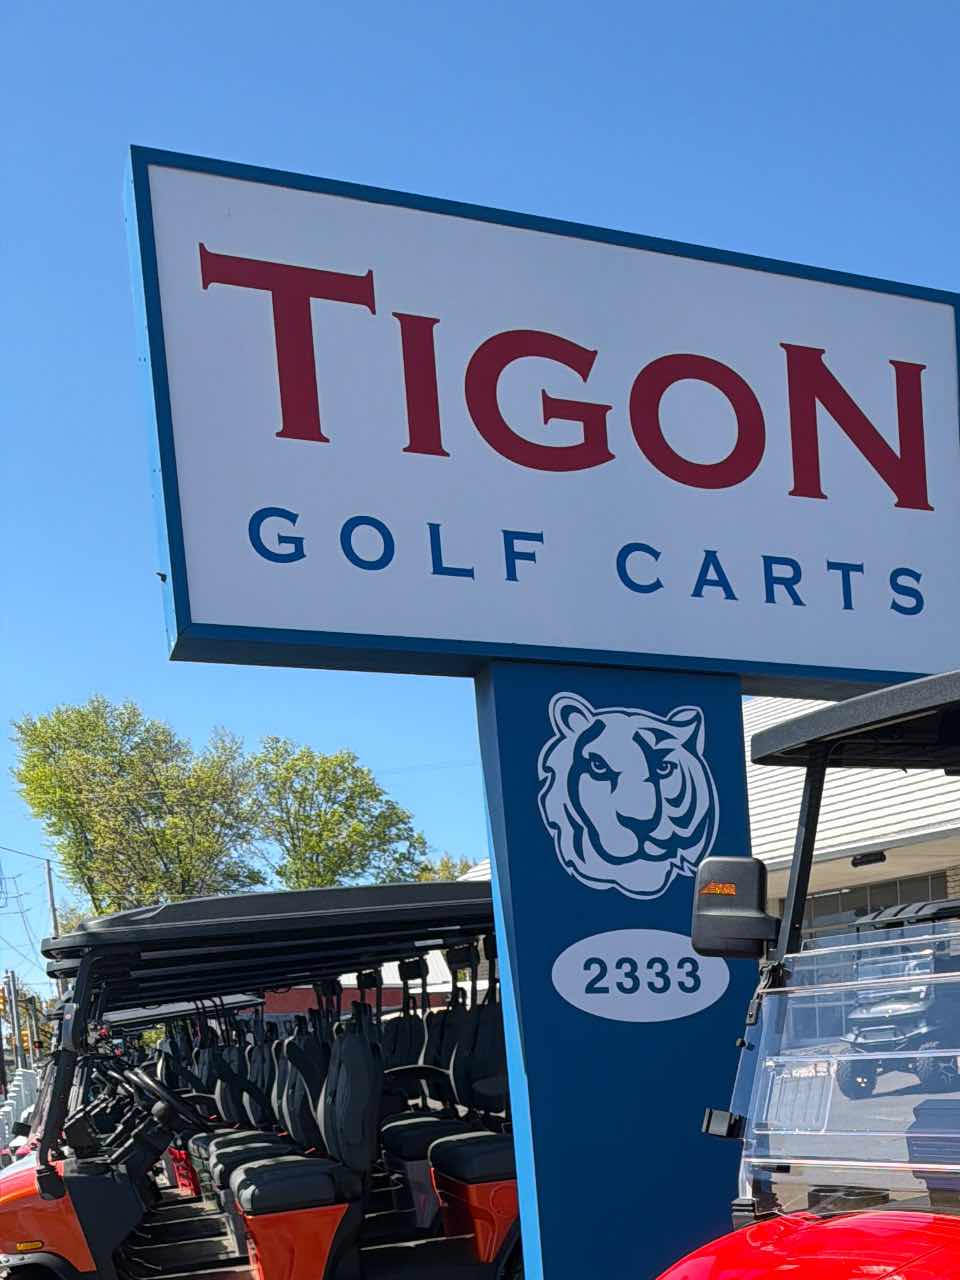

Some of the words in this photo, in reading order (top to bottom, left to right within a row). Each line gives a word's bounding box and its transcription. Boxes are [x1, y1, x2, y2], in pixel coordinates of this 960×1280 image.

[199, 242, 935, 512] TIGON
[247, 506, 545, 583] GOLF
[615, 542, 925, 616] CARTS
[583, 956, 702, 994] 2333
